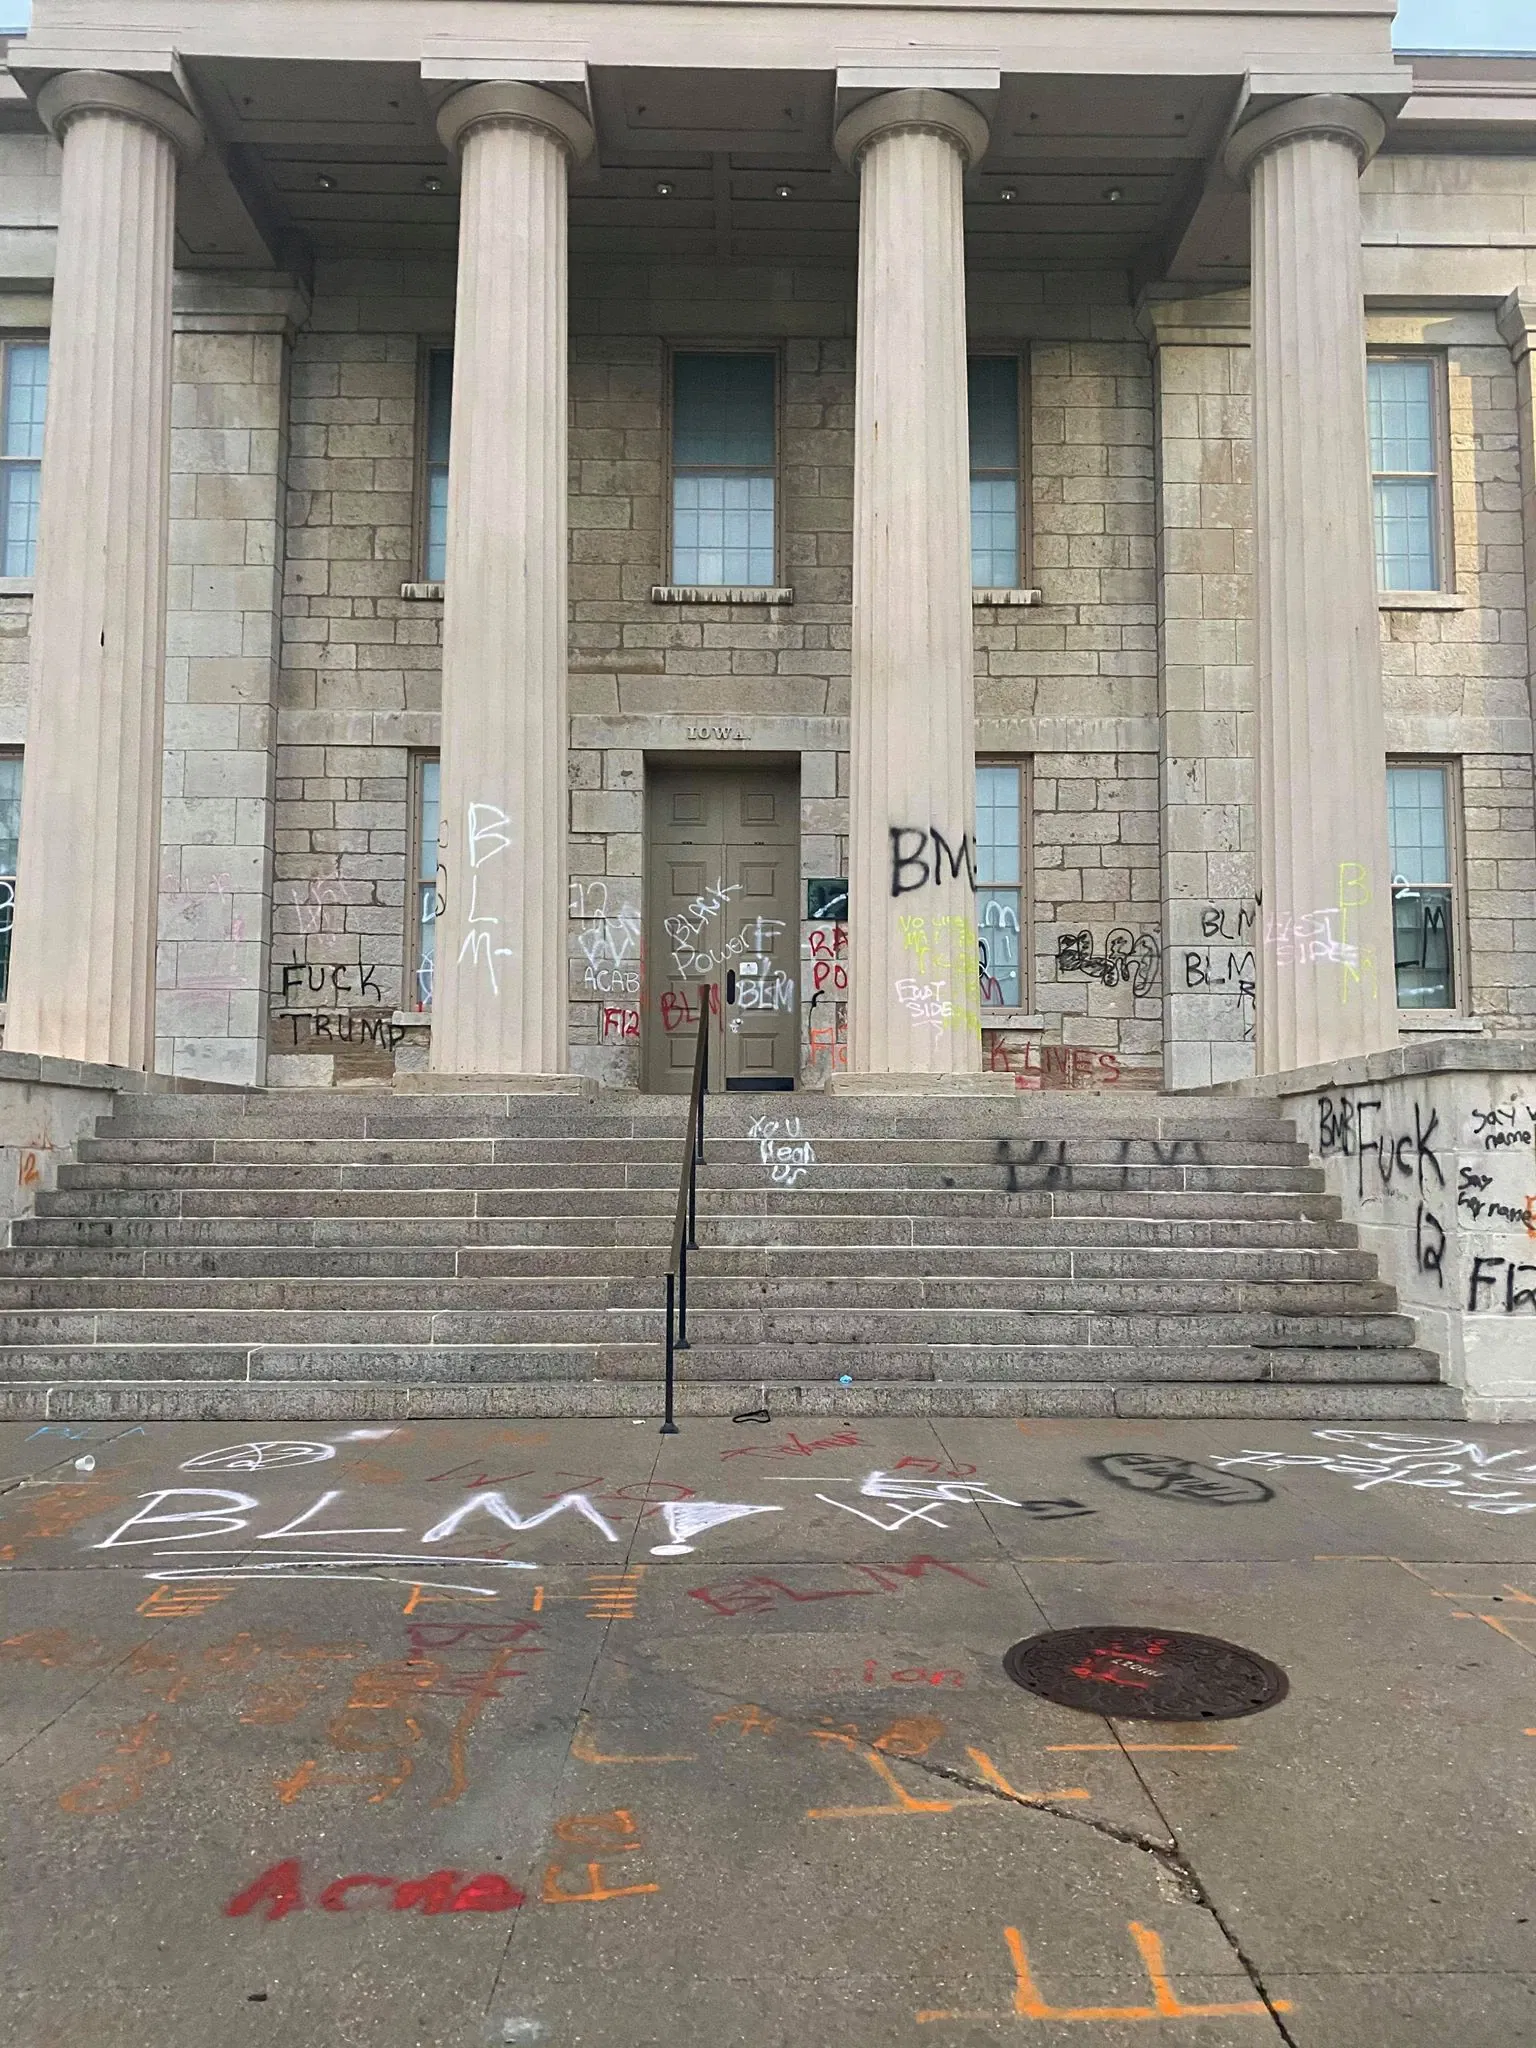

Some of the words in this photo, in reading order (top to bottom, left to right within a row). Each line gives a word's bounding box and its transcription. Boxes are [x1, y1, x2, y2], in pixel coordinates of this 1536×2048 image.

[282, 950, 384, 1003] FUCK
[584, 966, 641, 993] ACAB
[906, 1001, 954, 1017] SIDE
[280, 1012, 405, 1052] TRUMP
